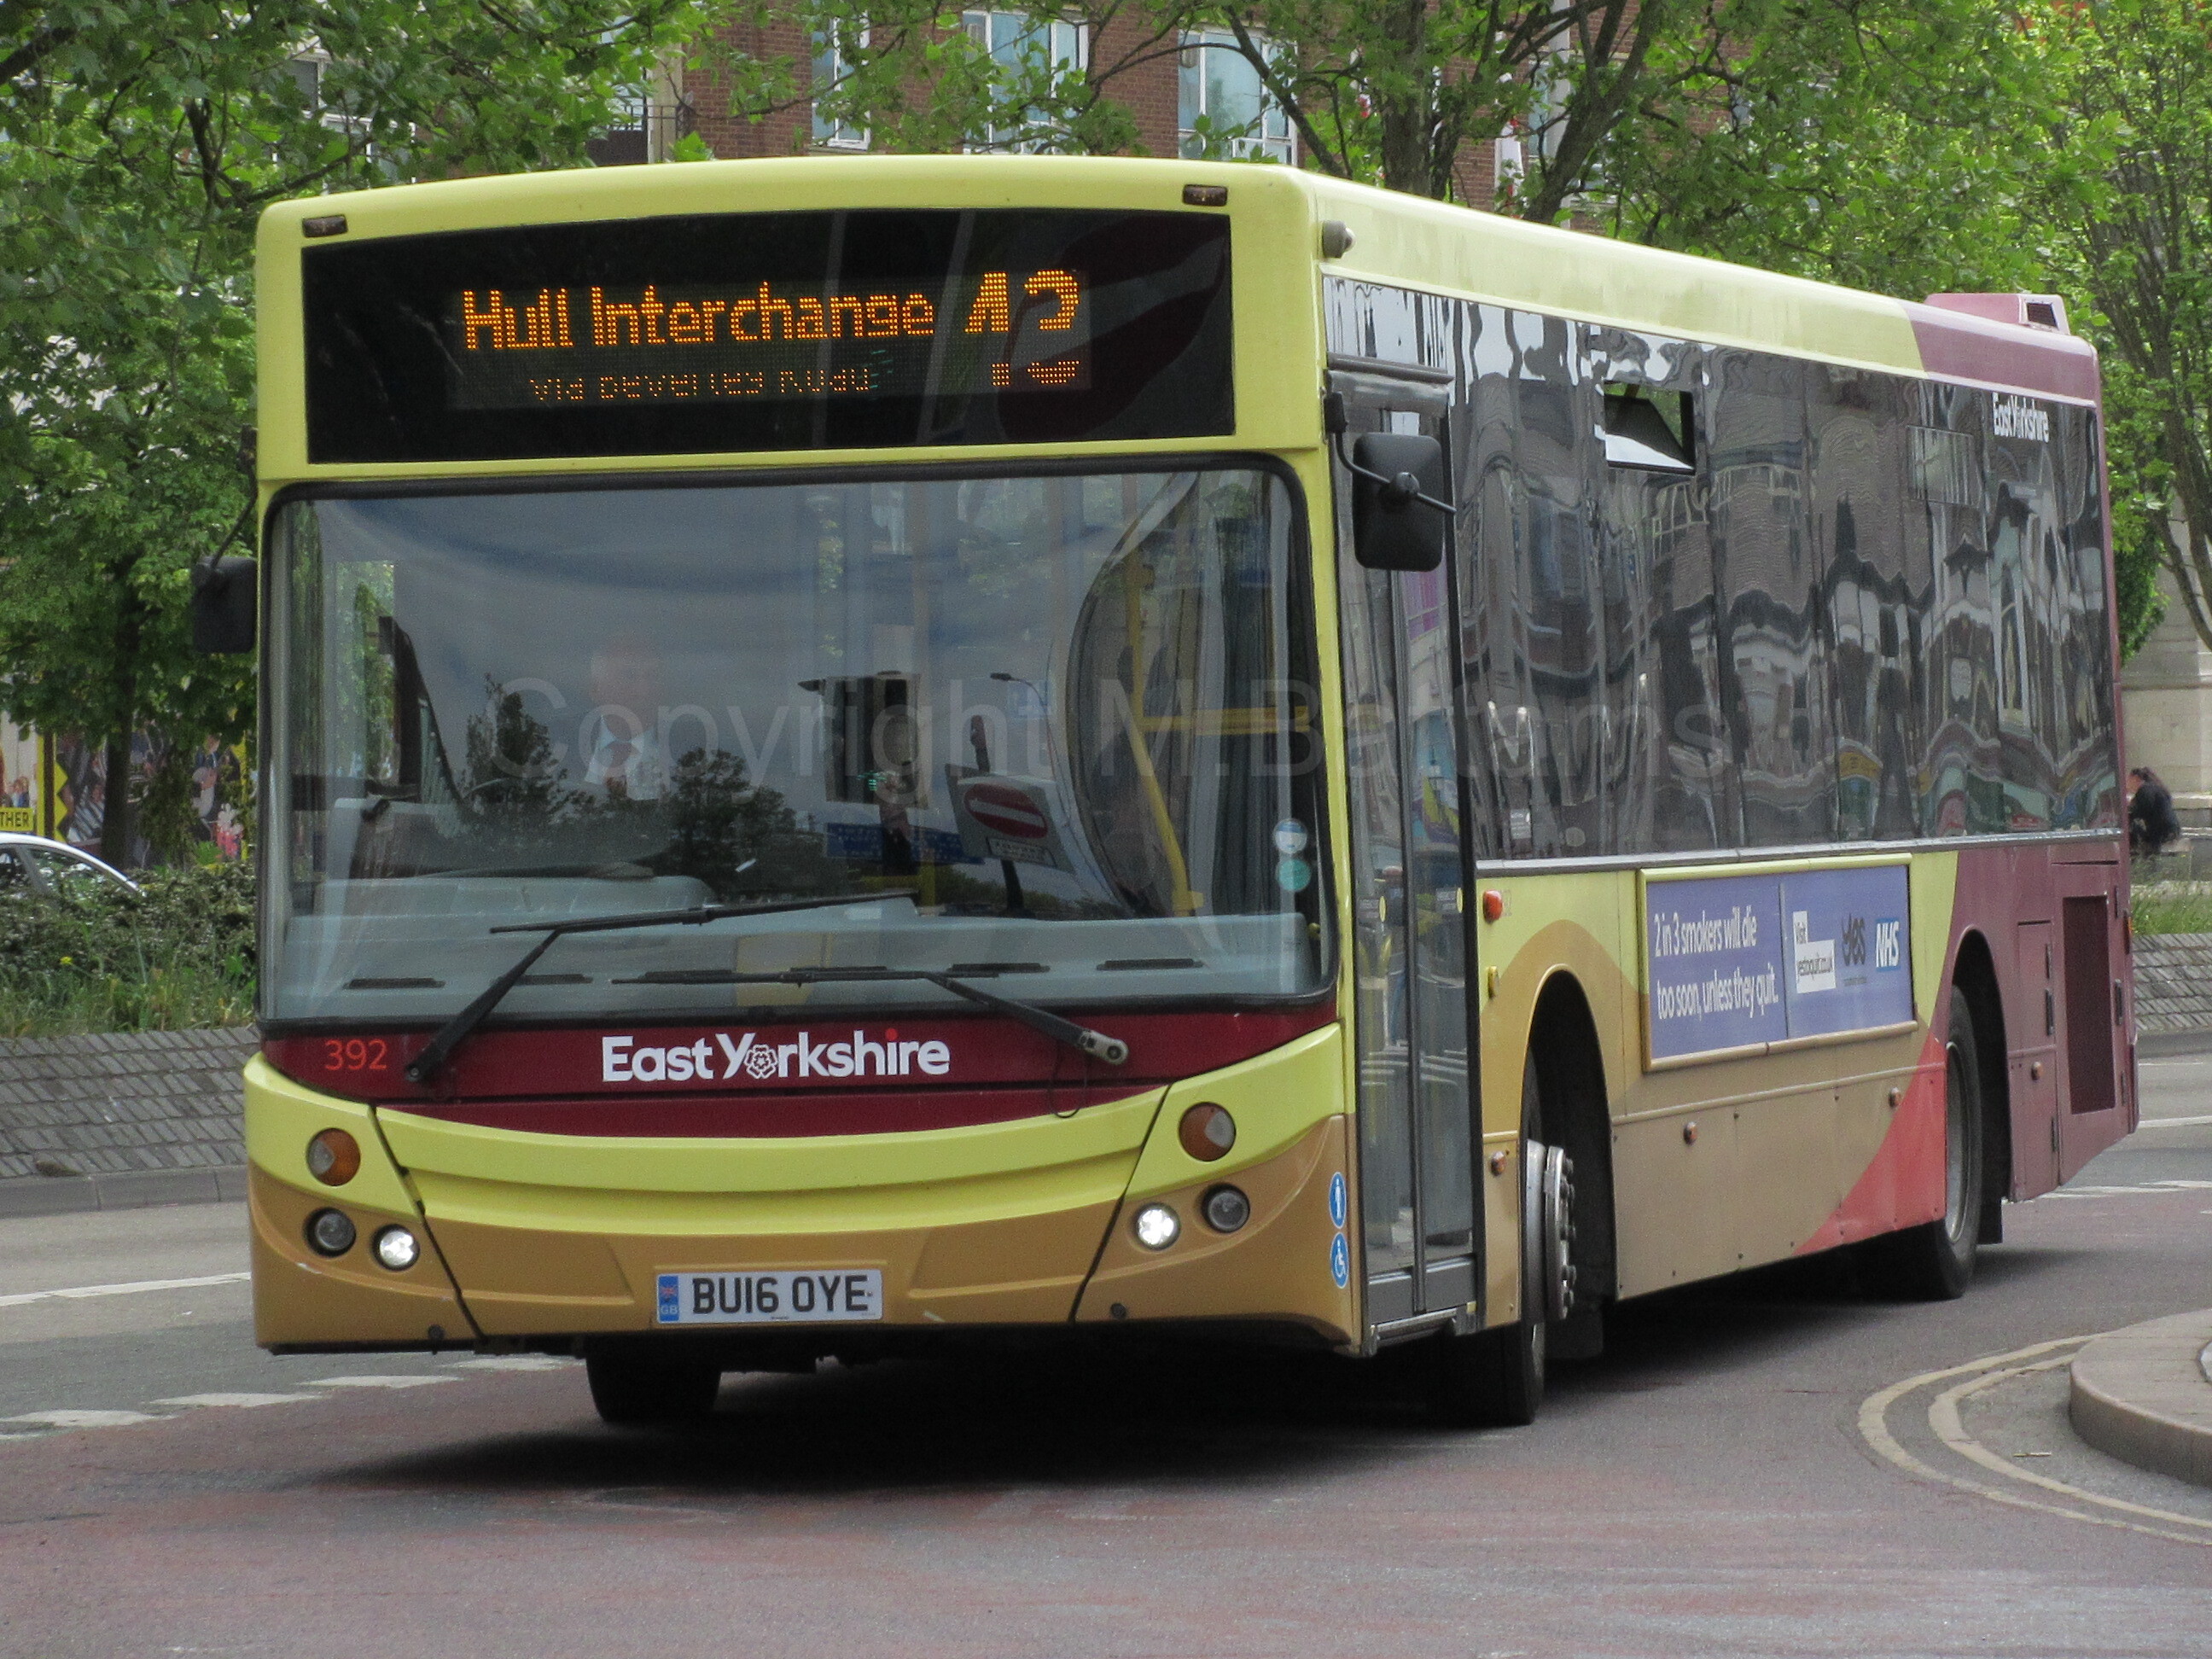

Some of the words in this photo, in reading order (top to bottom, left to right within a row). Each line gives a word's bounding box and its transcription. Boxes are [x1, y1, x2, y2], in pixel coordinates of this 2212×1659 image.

[463, 287, 575, 352] Hull
[591, 280, 937, 347] Interchange
[1654, 913, 1662, 958] 2
[1662, 912, 1672, 956] in
[1673, 911, 1679, 956] 3
[1680, 910, 1722, 955] smokers
[1723, 905, 1741, 949] will
[1742, 904, 1758, 947] die
[1875, 920, 1901, 969] NHS
[1656, 979, 1675, 1020] too
[1675, 982, 1703, 1022] soon,
[1702, 969, 1733, 1014] unless
[1733, 965, 1755, 1019] they
[1755, 962, 1779, 1016] quit.
[323, 1039, 388, 1072] 392
[601, 1035, 714, 1083] East
[715, 1027, 951, 1081] Yorkshire
[660, 1304, 678, 1315] GB
[692, 1276, 779, 1314] BU16
[791, 1274, 869, 1313] OYE
